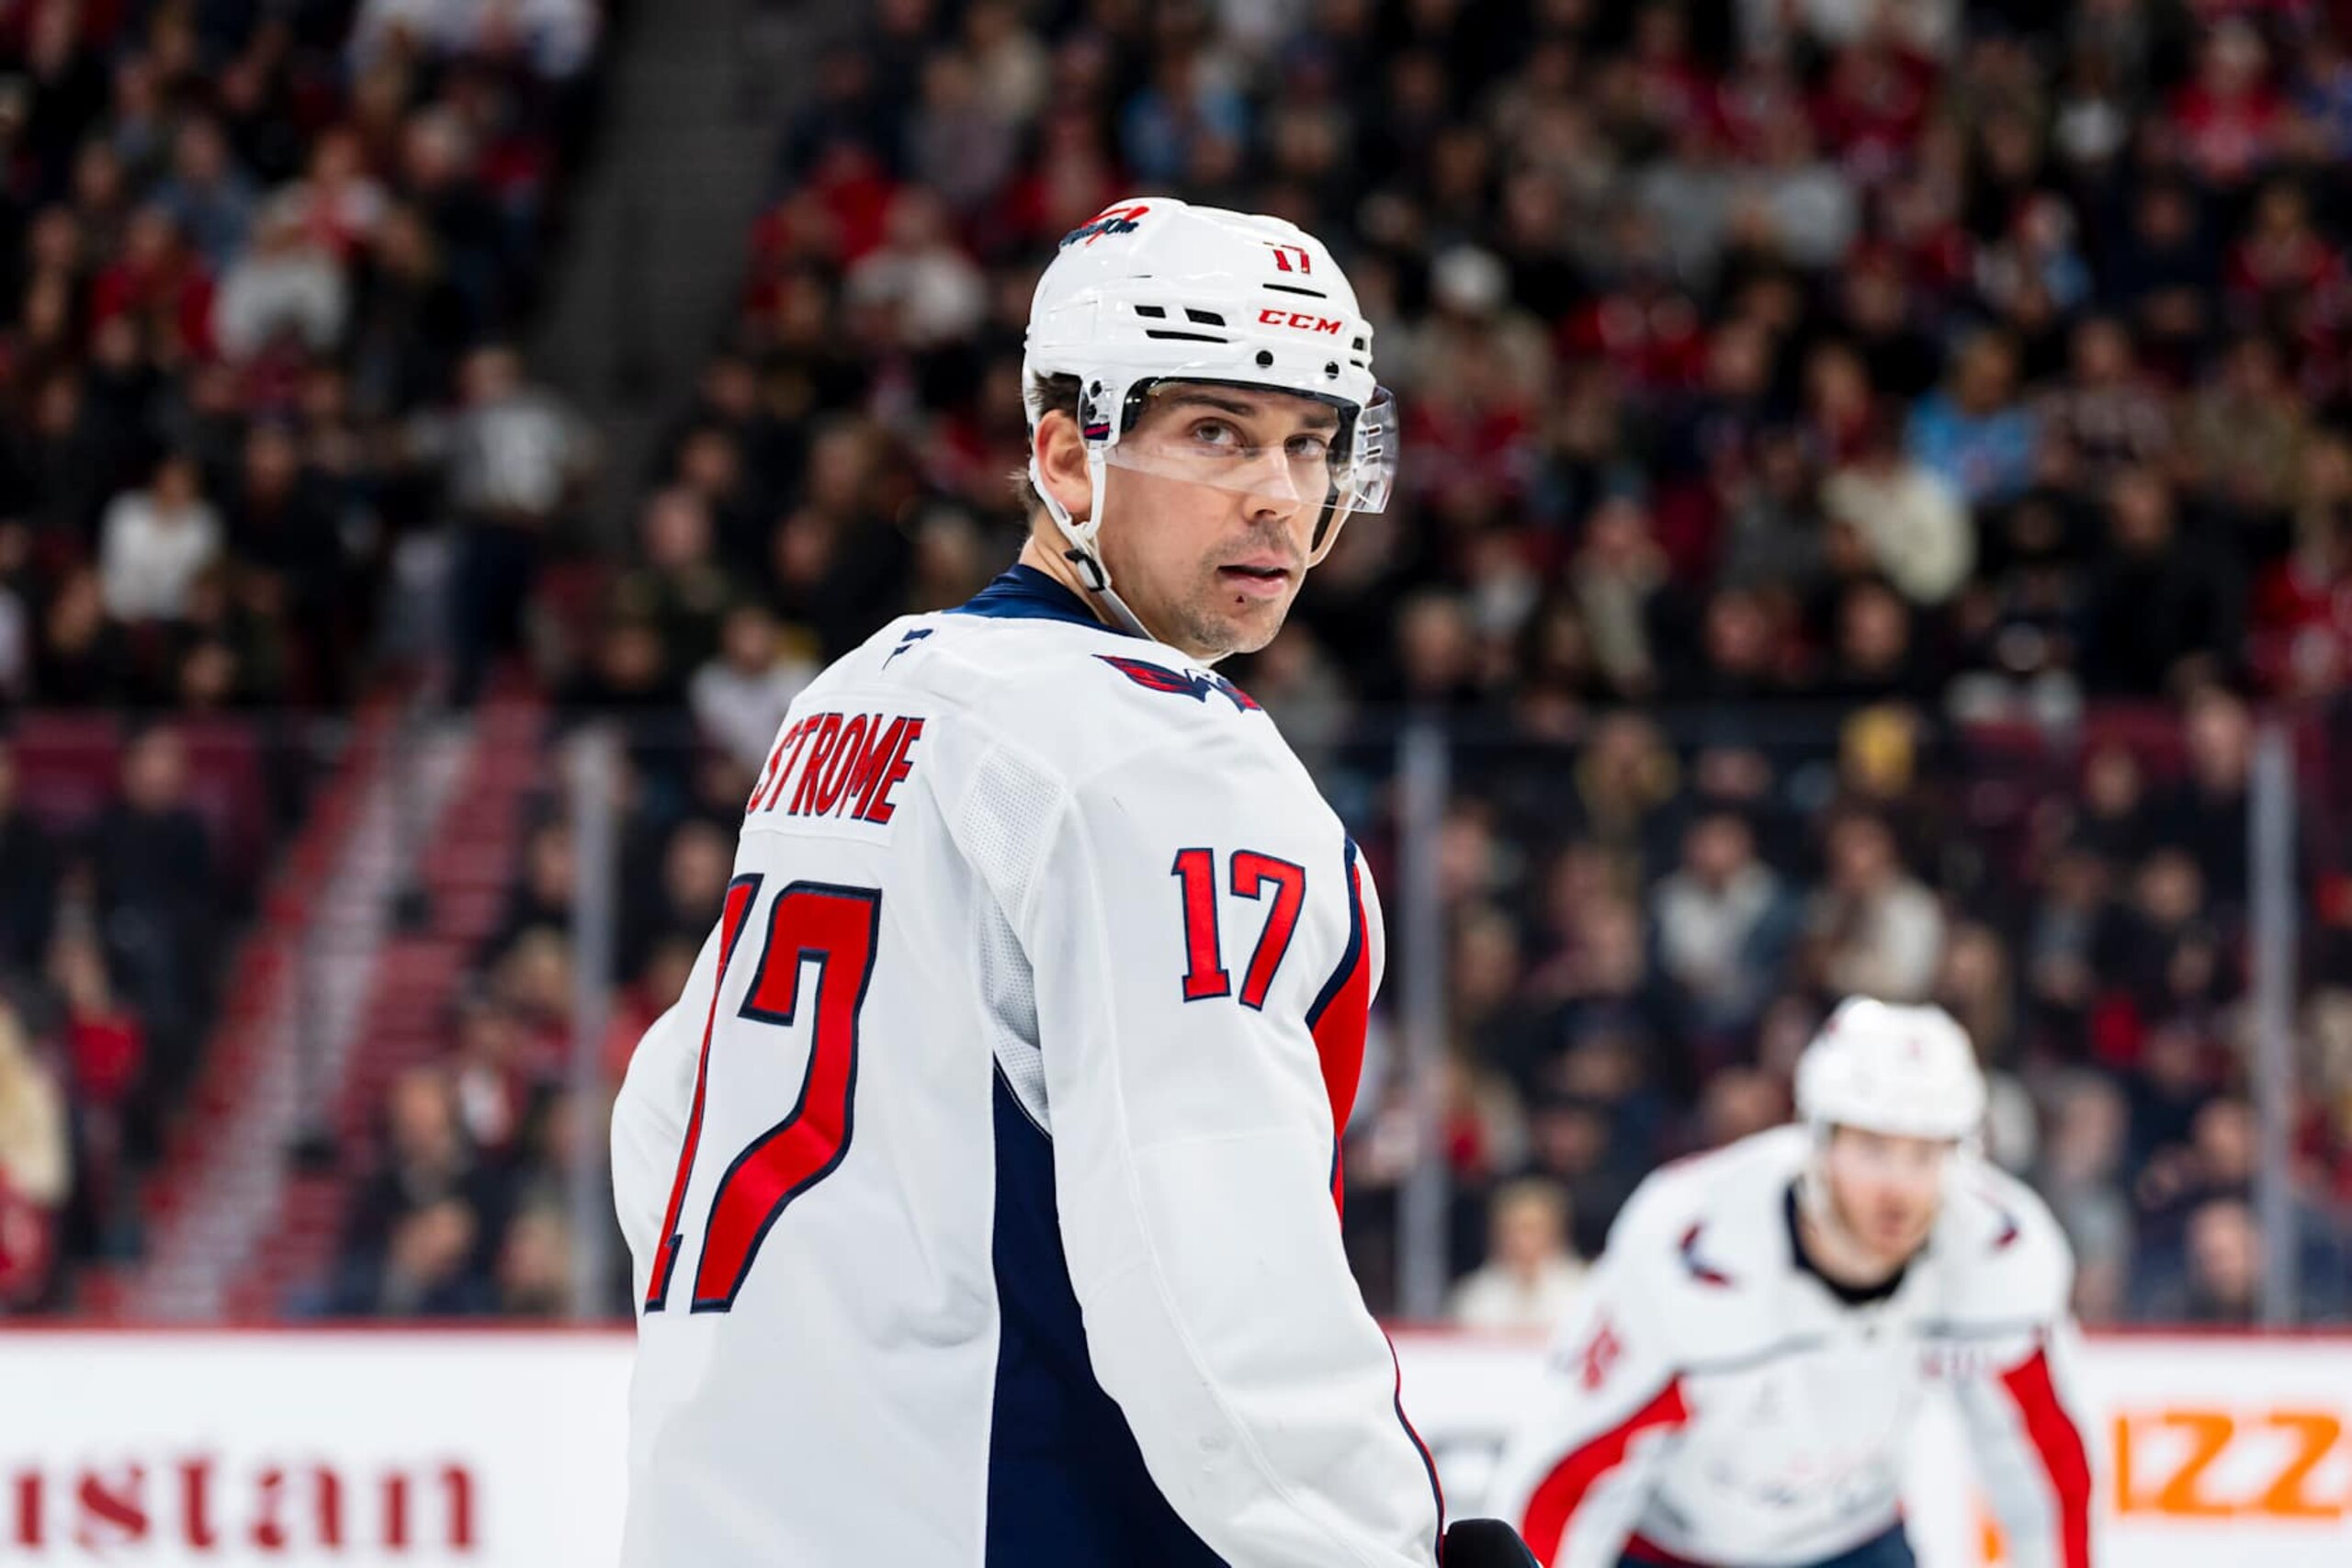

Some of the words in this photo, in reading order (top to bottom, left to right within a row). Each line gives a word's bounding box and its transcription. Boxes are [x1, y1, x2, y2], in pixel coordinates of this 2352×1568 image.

[1263, 242, 1310, 274] 17
[1258, 309, 1342, 334] CCM
[745, 712, 925, 825] STROME
[1171, 847, 1306, 1011] 17
